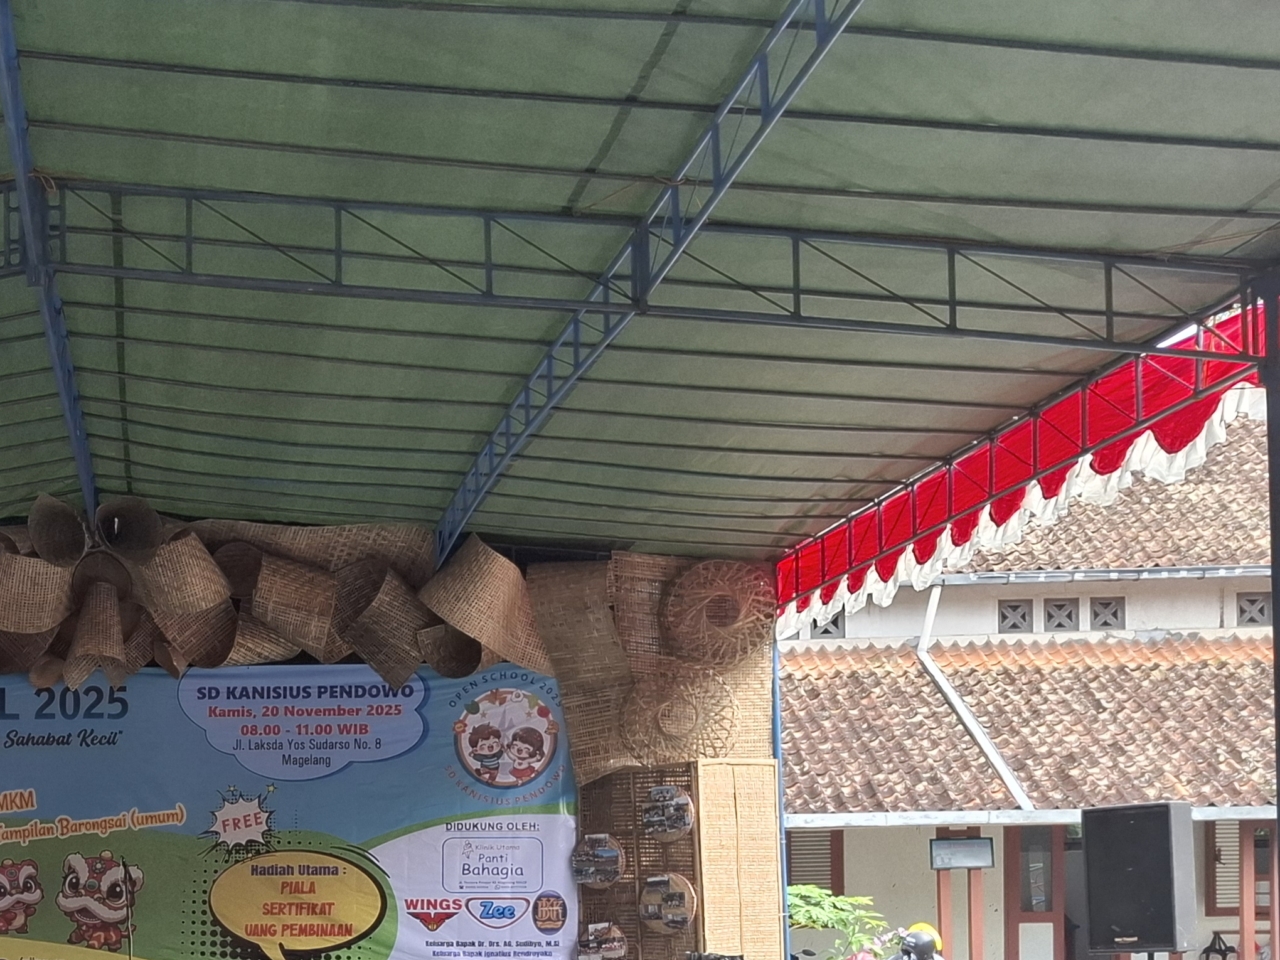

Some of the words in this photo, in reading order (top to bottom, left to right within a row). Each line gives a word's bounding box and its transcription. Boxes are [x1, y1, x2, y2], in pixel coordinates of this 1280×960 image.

[196, 686, 220, 701] SD
[226, 685, 312, 700] KANISIUS
[316, 684, 415, 699] PENDOWO
[448, 680, 479, 708] OPEN
[481, 671, 536, 685] SCHOOL
[33, 685, 129, 721] 2025
[207, 705, 257, 719] Kamis,
[261, 705, 280, 718] 20
[283, 704, 363, 717] November
[366, 704, 403, 717] 2025
[240, 724, 282, 737] 08.00
[295, 723, 334, 736] 11.00
[337, 723, 370, 736] WIB
[3, 730, 73, 749] Sahabat
[248, 739, 284, 751] Laksda
[287, 738, 306, 751] Yos
[308, 737, 351, 750] Sudarso
[353, 738, 372, 750] No.
[375, 738, 382, 750] 8
[281, 753, 332, 769] Magelang
[57, 814, 127, 836] Barongsai
[130, 805, 185, 828] (umum)
[222, 811, 264, 834] FREE
[445, 822, 503, 832] DIDUKUNG
[506, 821, 541, 832] OLEH:
[478, 853, 509, 864] Panti
[250, 863, 295, 877] Hadiah
[298, 863, 340, 877] Utama
[461, 863, 525, 880] Bahagia
[280, 880, 317, 895] PIALA
[261, 902, 336, 917] SERTIFIKAT
[404, 899, 463, 911] WINGS
[479, 900, 516, 920] Zee
[244, 923, 278, 938] UANG
[281, 923, 354, 938] PEMBINAAN
